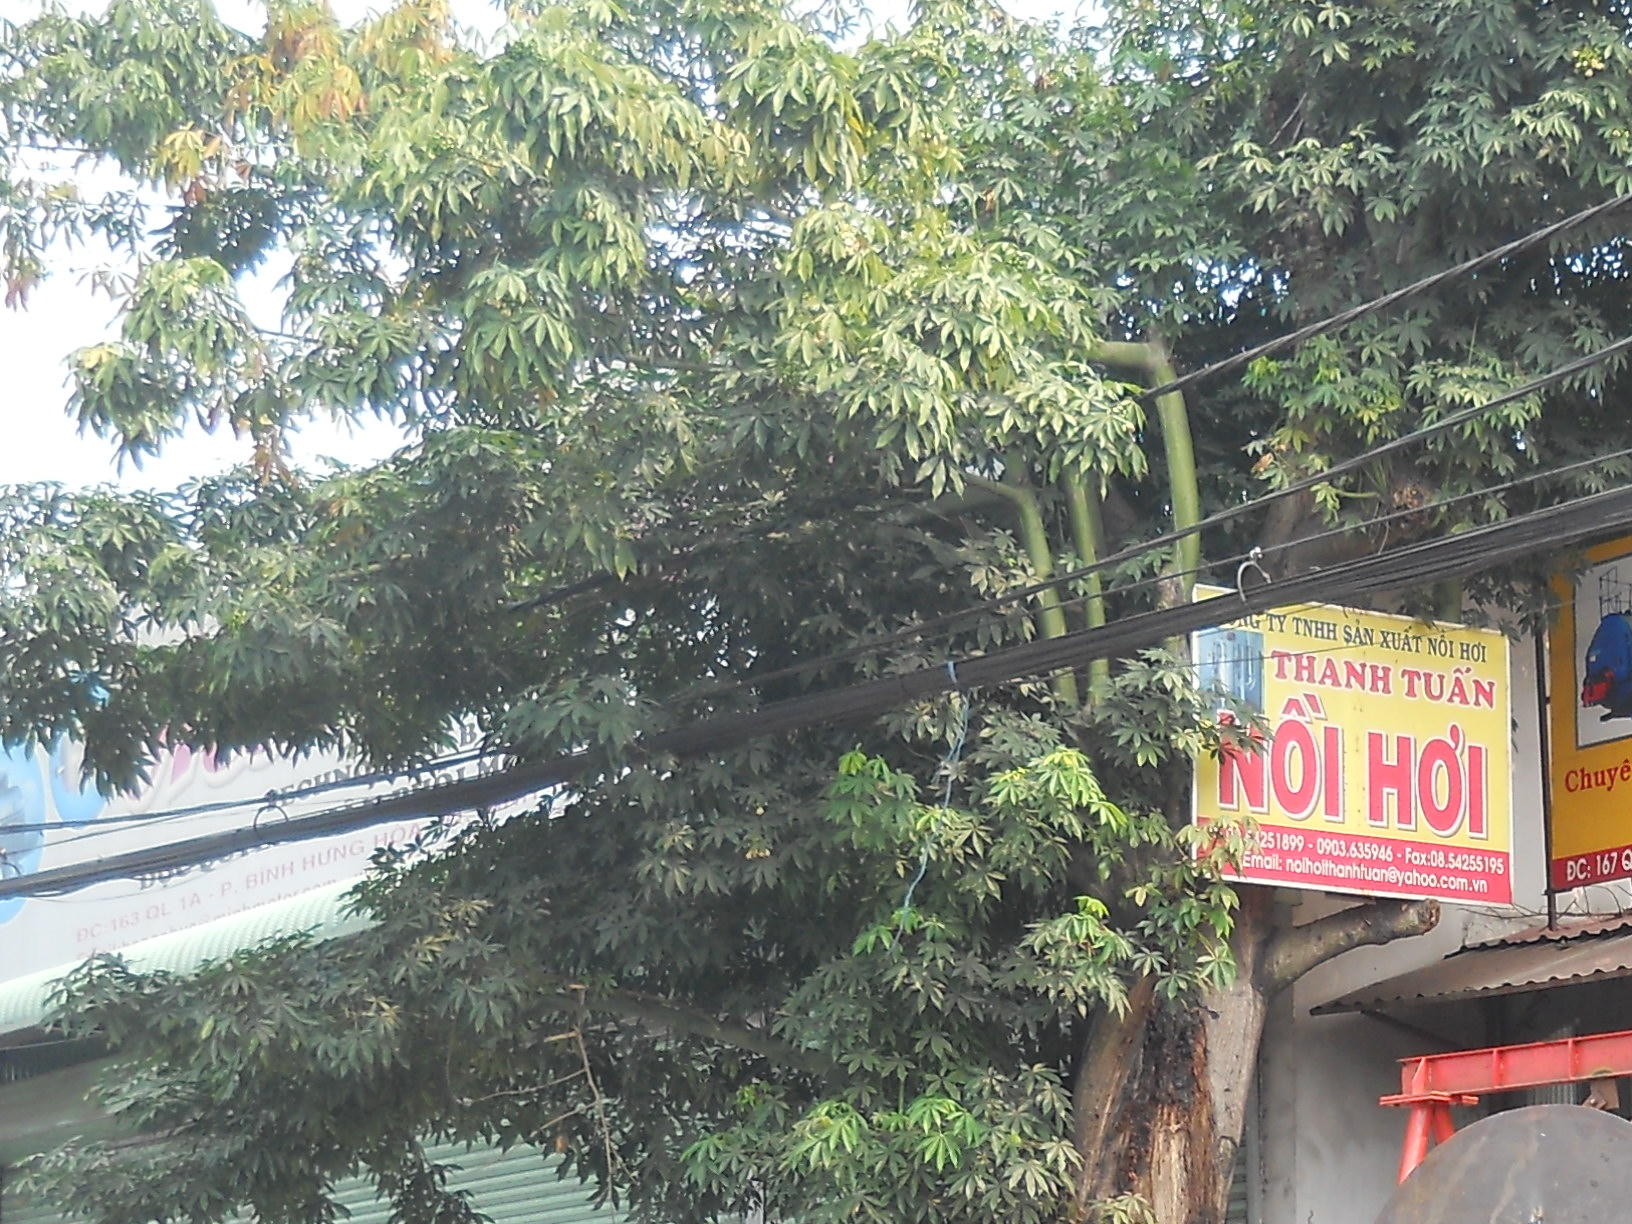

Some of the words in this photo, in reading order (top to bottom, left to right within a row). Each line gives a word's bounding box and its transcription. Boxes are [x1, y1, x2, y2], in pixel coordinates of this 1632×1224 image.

[1266, 612, 1288, 634] TY
[1291, 616, 1338, 641] TNHH
[1342, 618, 1375, 647] SẢN
[1379, 624, 1424, 653] XUẤT
[1426, 627, 1455, 660] NỒI
[1459, 640, 1488, 664] HƠI
[1270, 649, 1393, 696] THANH
[1400, 666, 1497, 711] TUẤN
[1217, 692, 1345, 823] NỒI
[1366, 724, 1489, 840] HƠI
[1242, 851, 1283, 871] Email:
[1316, 837, 1394, 863] 0903.635946
[1596, 854, 1618, 877] 167
